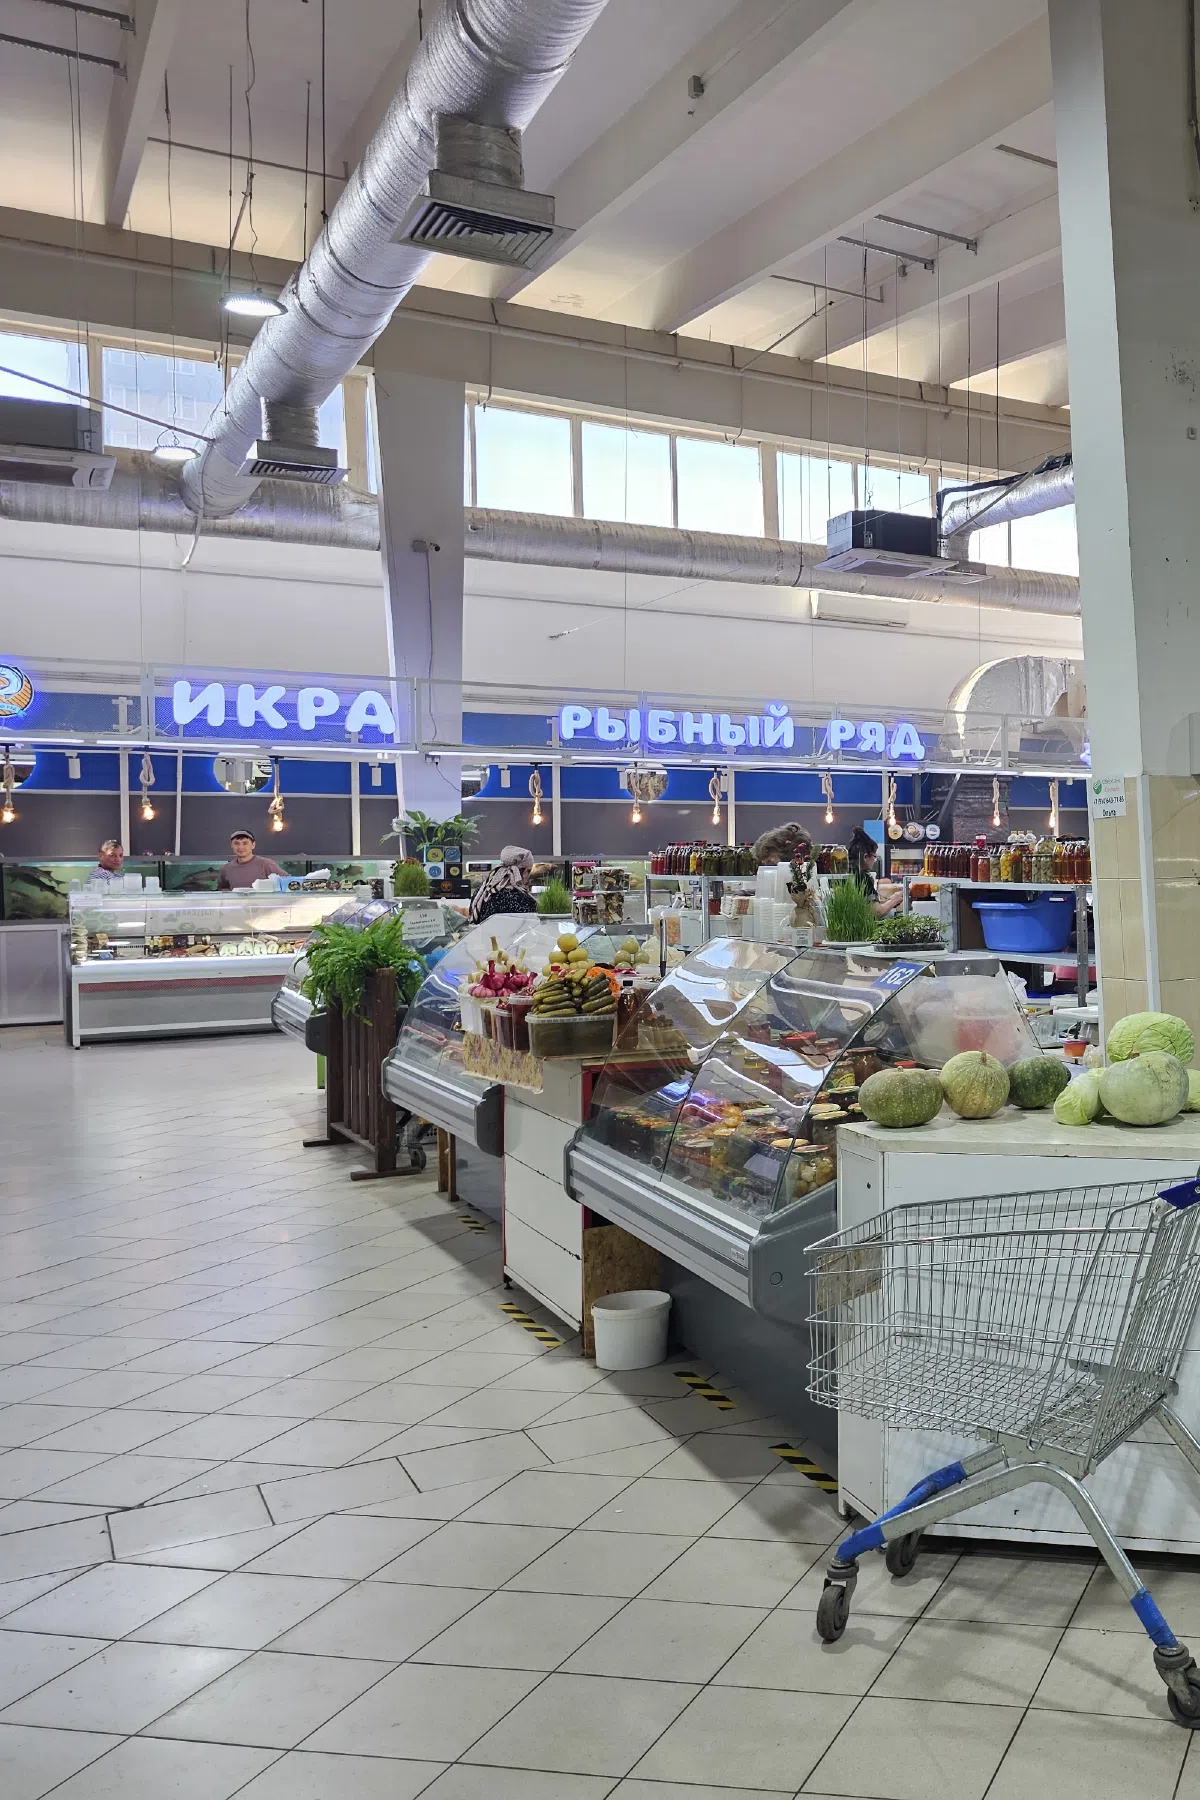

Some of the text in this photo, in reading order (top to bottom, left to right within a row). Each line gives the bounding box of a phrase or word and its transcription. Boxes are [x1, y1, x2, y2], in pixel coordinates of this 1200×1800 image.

[173, 680, 397, 734] ИКРА
[559, 703, 925, 760] РЫБНЫЙ РЯД
[880, 967, 915, 985] 162
